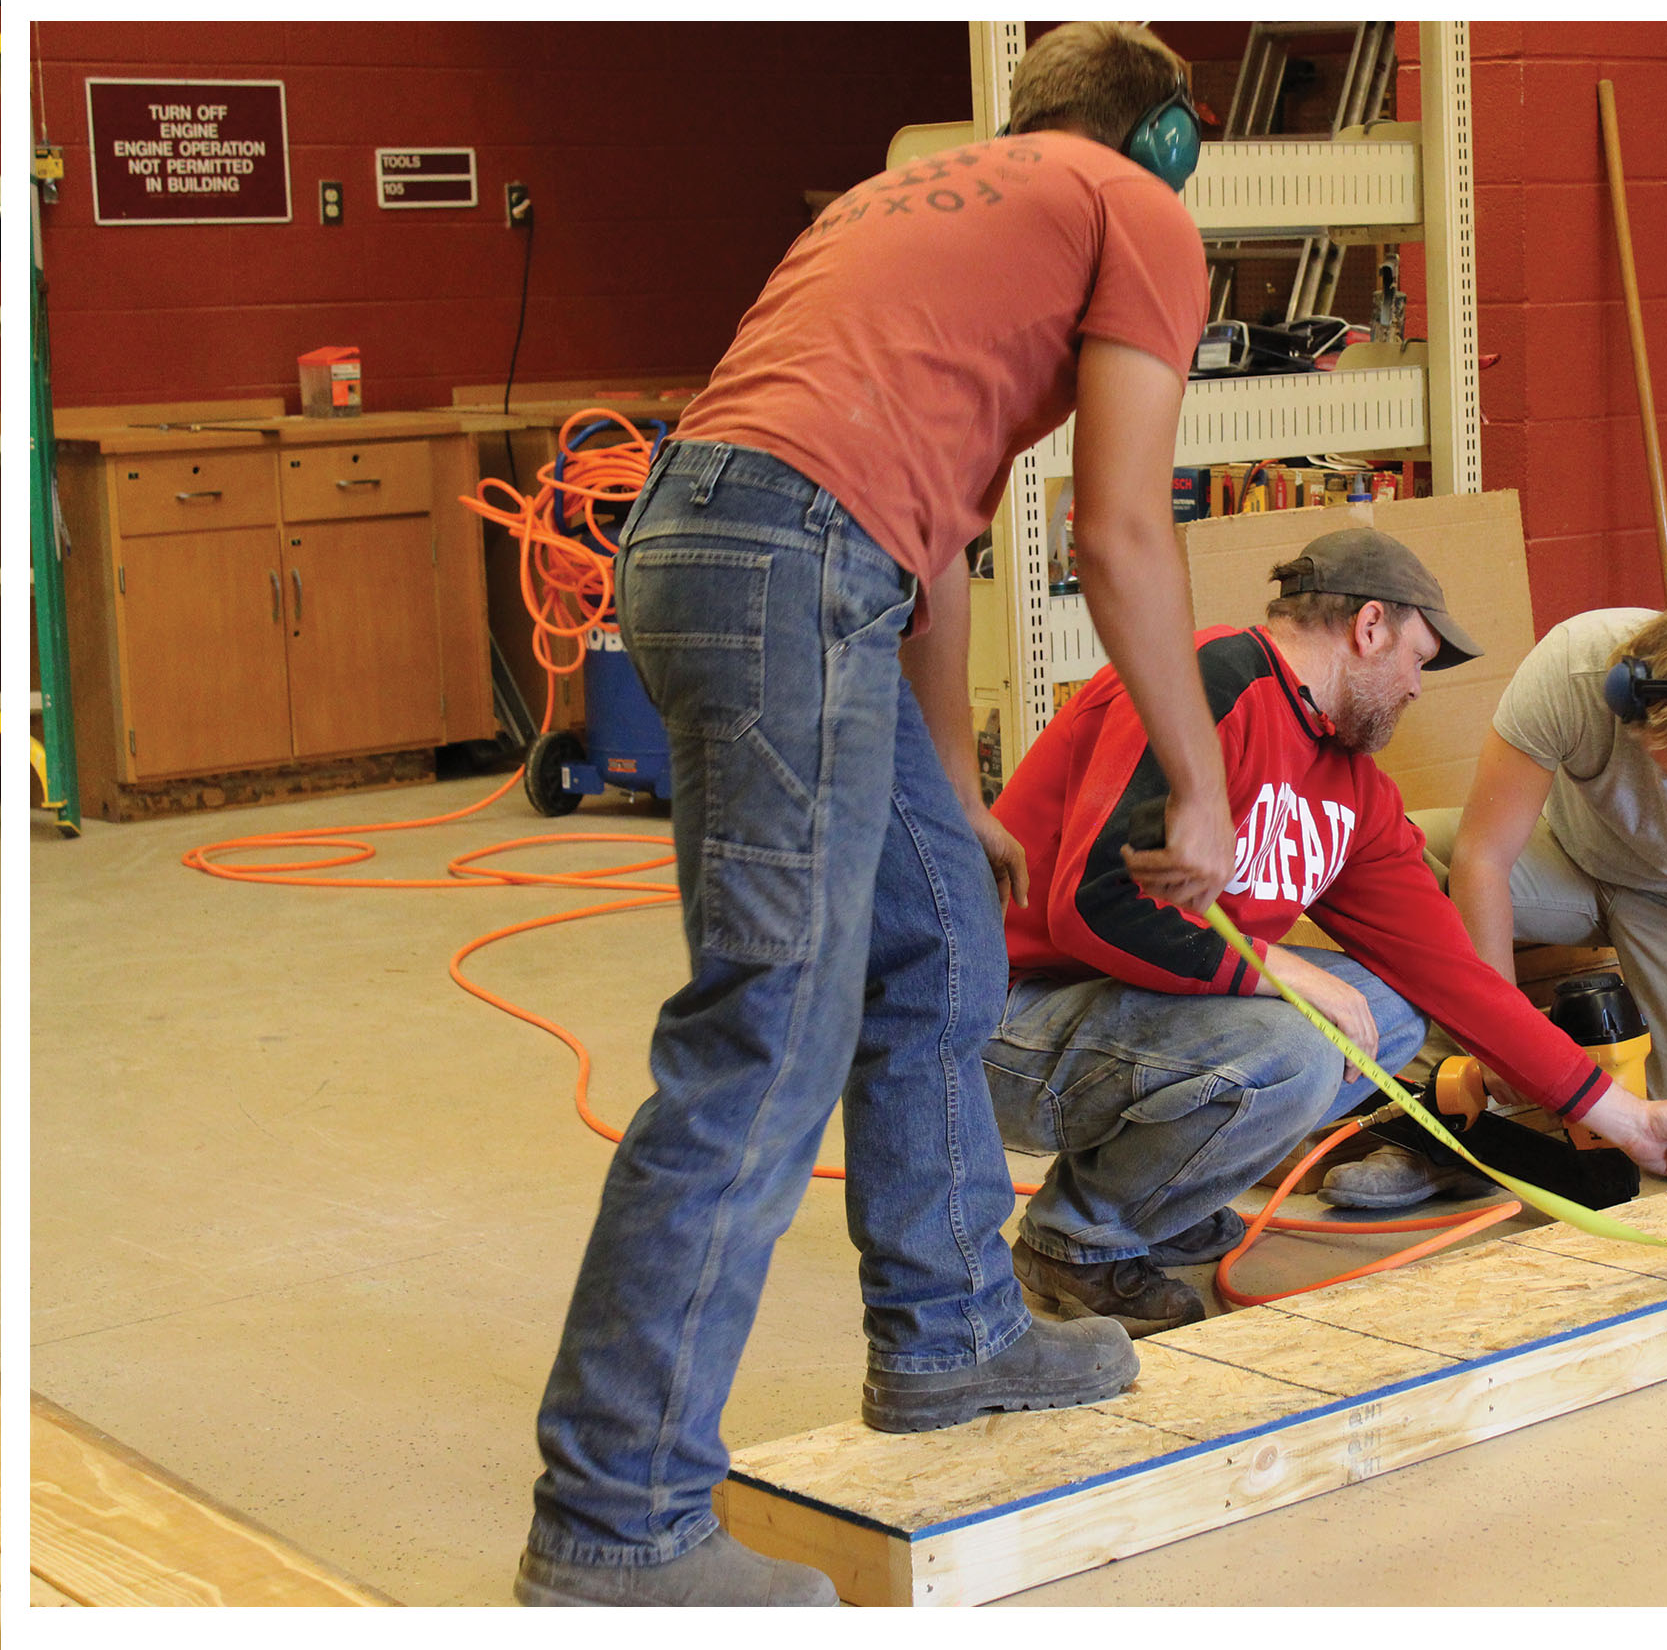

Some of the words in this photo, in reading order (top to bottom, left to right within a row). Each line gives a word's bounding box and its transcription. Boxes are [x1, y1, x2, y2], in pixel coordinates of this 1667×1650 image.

[149, 105, 191, 121] TURN
[197, 105, 228, 121] OFF
[160, 123, 218, 139] ENGINE
[114, 141, 173, 157] ENGINE
[179, 141, 266, 157] OPERATION
[128, 159, 161, 175] NOT
[167, 159, 254, 175] PERMITTED
[382, 156, 421, 168] TOOLS
[146, 177, 162, 192] IN
[168, 177, 240, 192] BUILDING
[384, 182, 405, 195] 105
[1172, 478, 1192, 490] SCH
